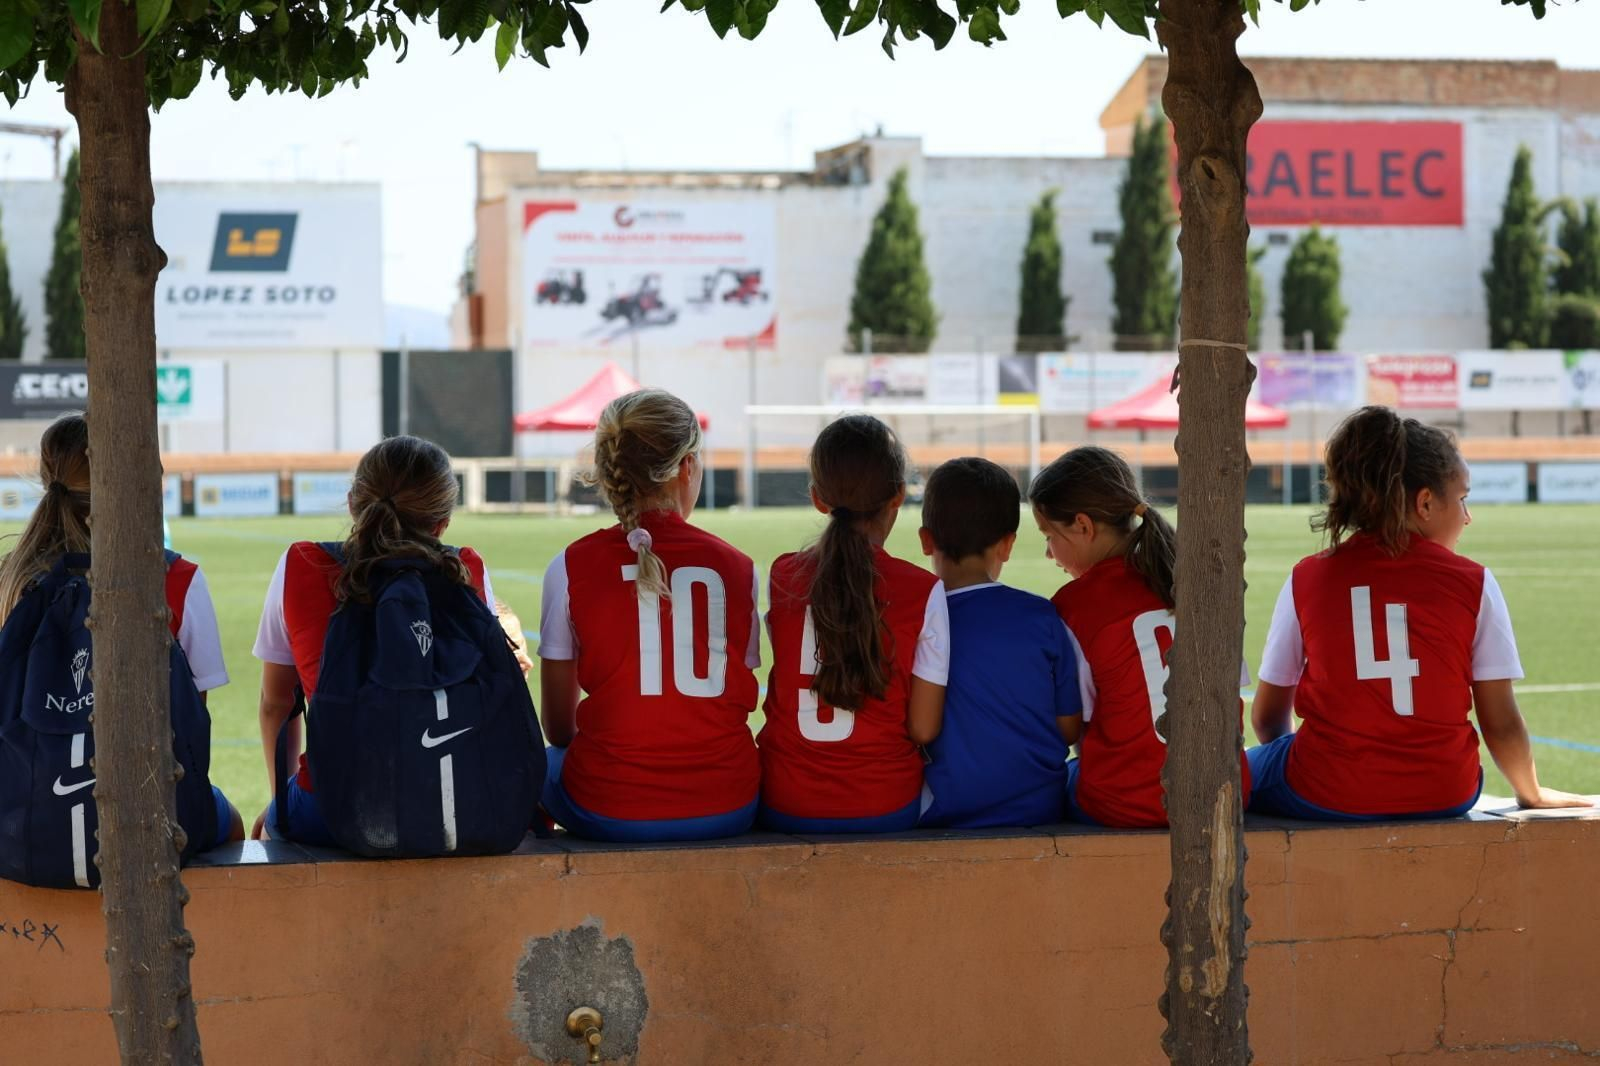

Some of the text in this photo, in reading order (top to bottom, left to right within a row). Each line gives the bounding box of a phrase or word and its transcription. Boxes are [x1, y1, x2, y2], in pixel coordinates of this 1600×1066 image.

[167, 286, 337, 304] LOPEZ SOTO
[621, 565, 727, 697] 10
[1351, 586, 1420, 716] 4
